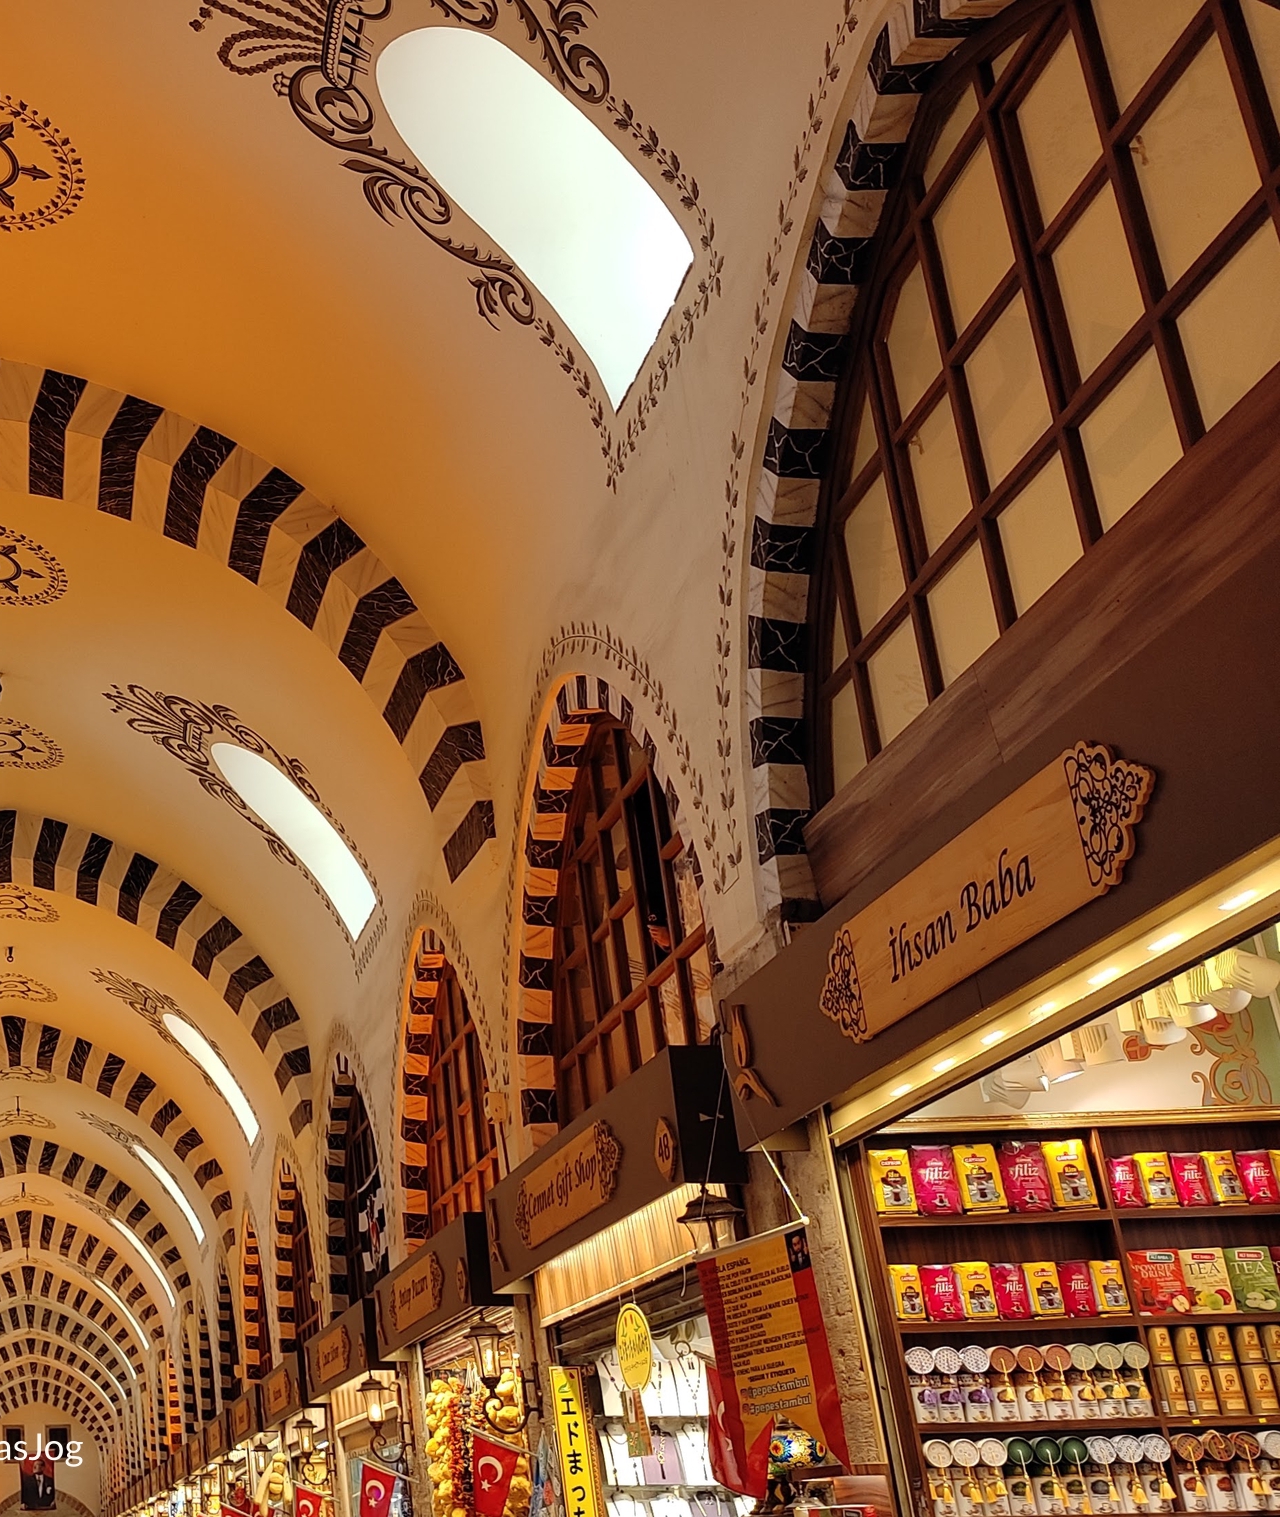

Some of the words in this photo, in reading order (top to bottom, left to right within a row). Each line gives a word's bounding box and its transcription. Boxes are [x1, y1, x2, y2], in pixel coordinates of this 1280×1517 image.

[889, 910, 957, 984] İhsan
[959, 848, 1036, 933] Baba
[658, 1133, 671, 1163] 48
[923, 1166, 951, 1183] filiz
[1013, 1163, 1040, 1181] filiz
[527, 1179, 555, 1220] Cennet
[556, 1162, 573, 1207] Gift
[574, 1152, 597, 1191] Shop
[1132, 1263, 1176, 1273] POWDER
[1140, 1269, 1174, 1279] DRINK
[1185, 1262, 1221, 1276] TEA
[1230, 1261, 1268, 1275] TEA
[934, 1282, 954, 1295] filiz
